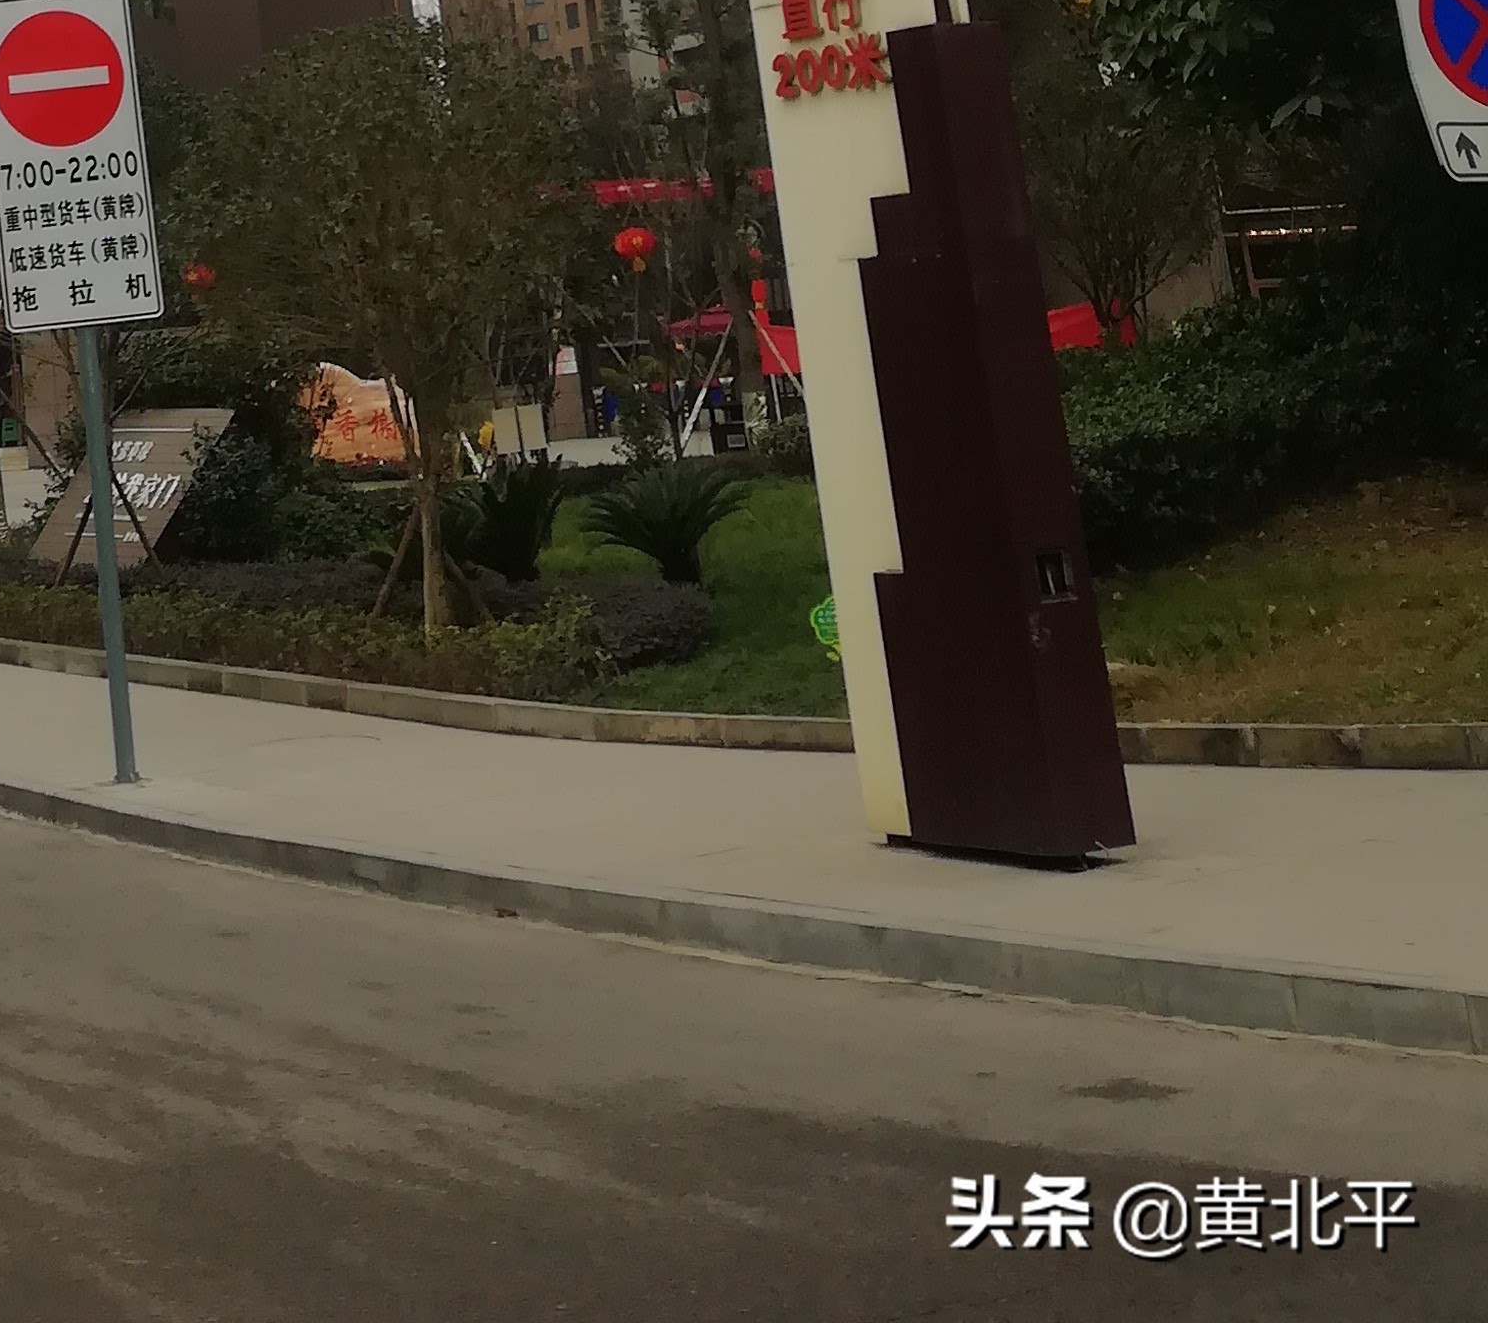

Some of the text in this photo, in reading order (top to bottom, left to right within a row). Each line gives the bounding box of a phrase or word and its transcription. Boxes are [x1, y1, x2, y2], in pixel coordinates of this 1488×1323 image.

[772, 32, 890, 101] 200米
[0, 150, 138, 191] 7:00-22:00
[4, 192, 144, 233] 重中型货车(黄牌)
[9, 232, 149, 273] 低速货车(黄牌)
